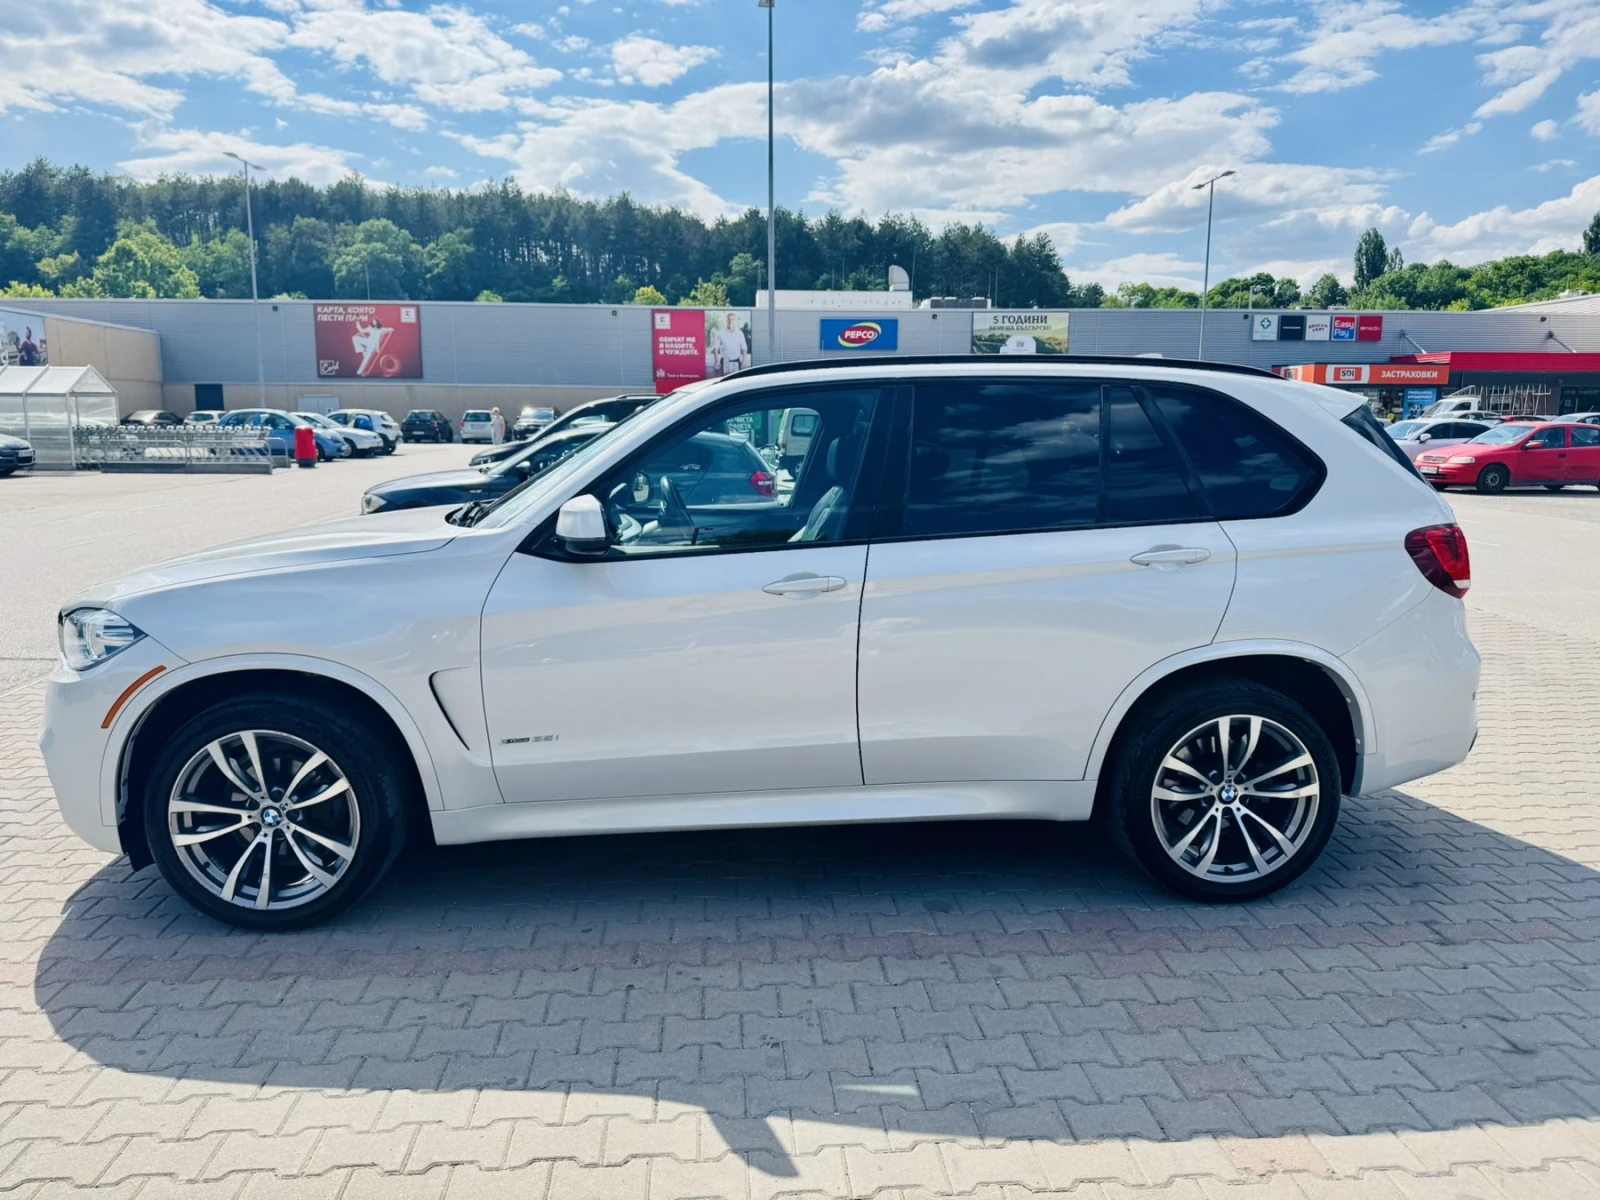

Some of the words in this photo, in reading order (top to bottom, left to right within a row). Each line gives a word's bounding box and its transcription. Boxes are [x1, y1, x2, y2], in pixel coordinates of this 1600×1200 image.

[316, 306, 346, 314] КАРТА,
[347, 306, 376, 314] КОЯТО
[317, 314, 345, 322] ПЕСТИ
[993, 315, 999, 324] 5
[1002, 315, 1048, 325] ГОДИНИ
[1334, 319, 1355, 329] Easy
[844, 330, 875, 339] PEPCO
[1333, 329, 1350, 339] Pay
[1341, 369, 1355, 377] SDI
[1380, 369, 1438, 379] ЗАСТРАХОВКИ
